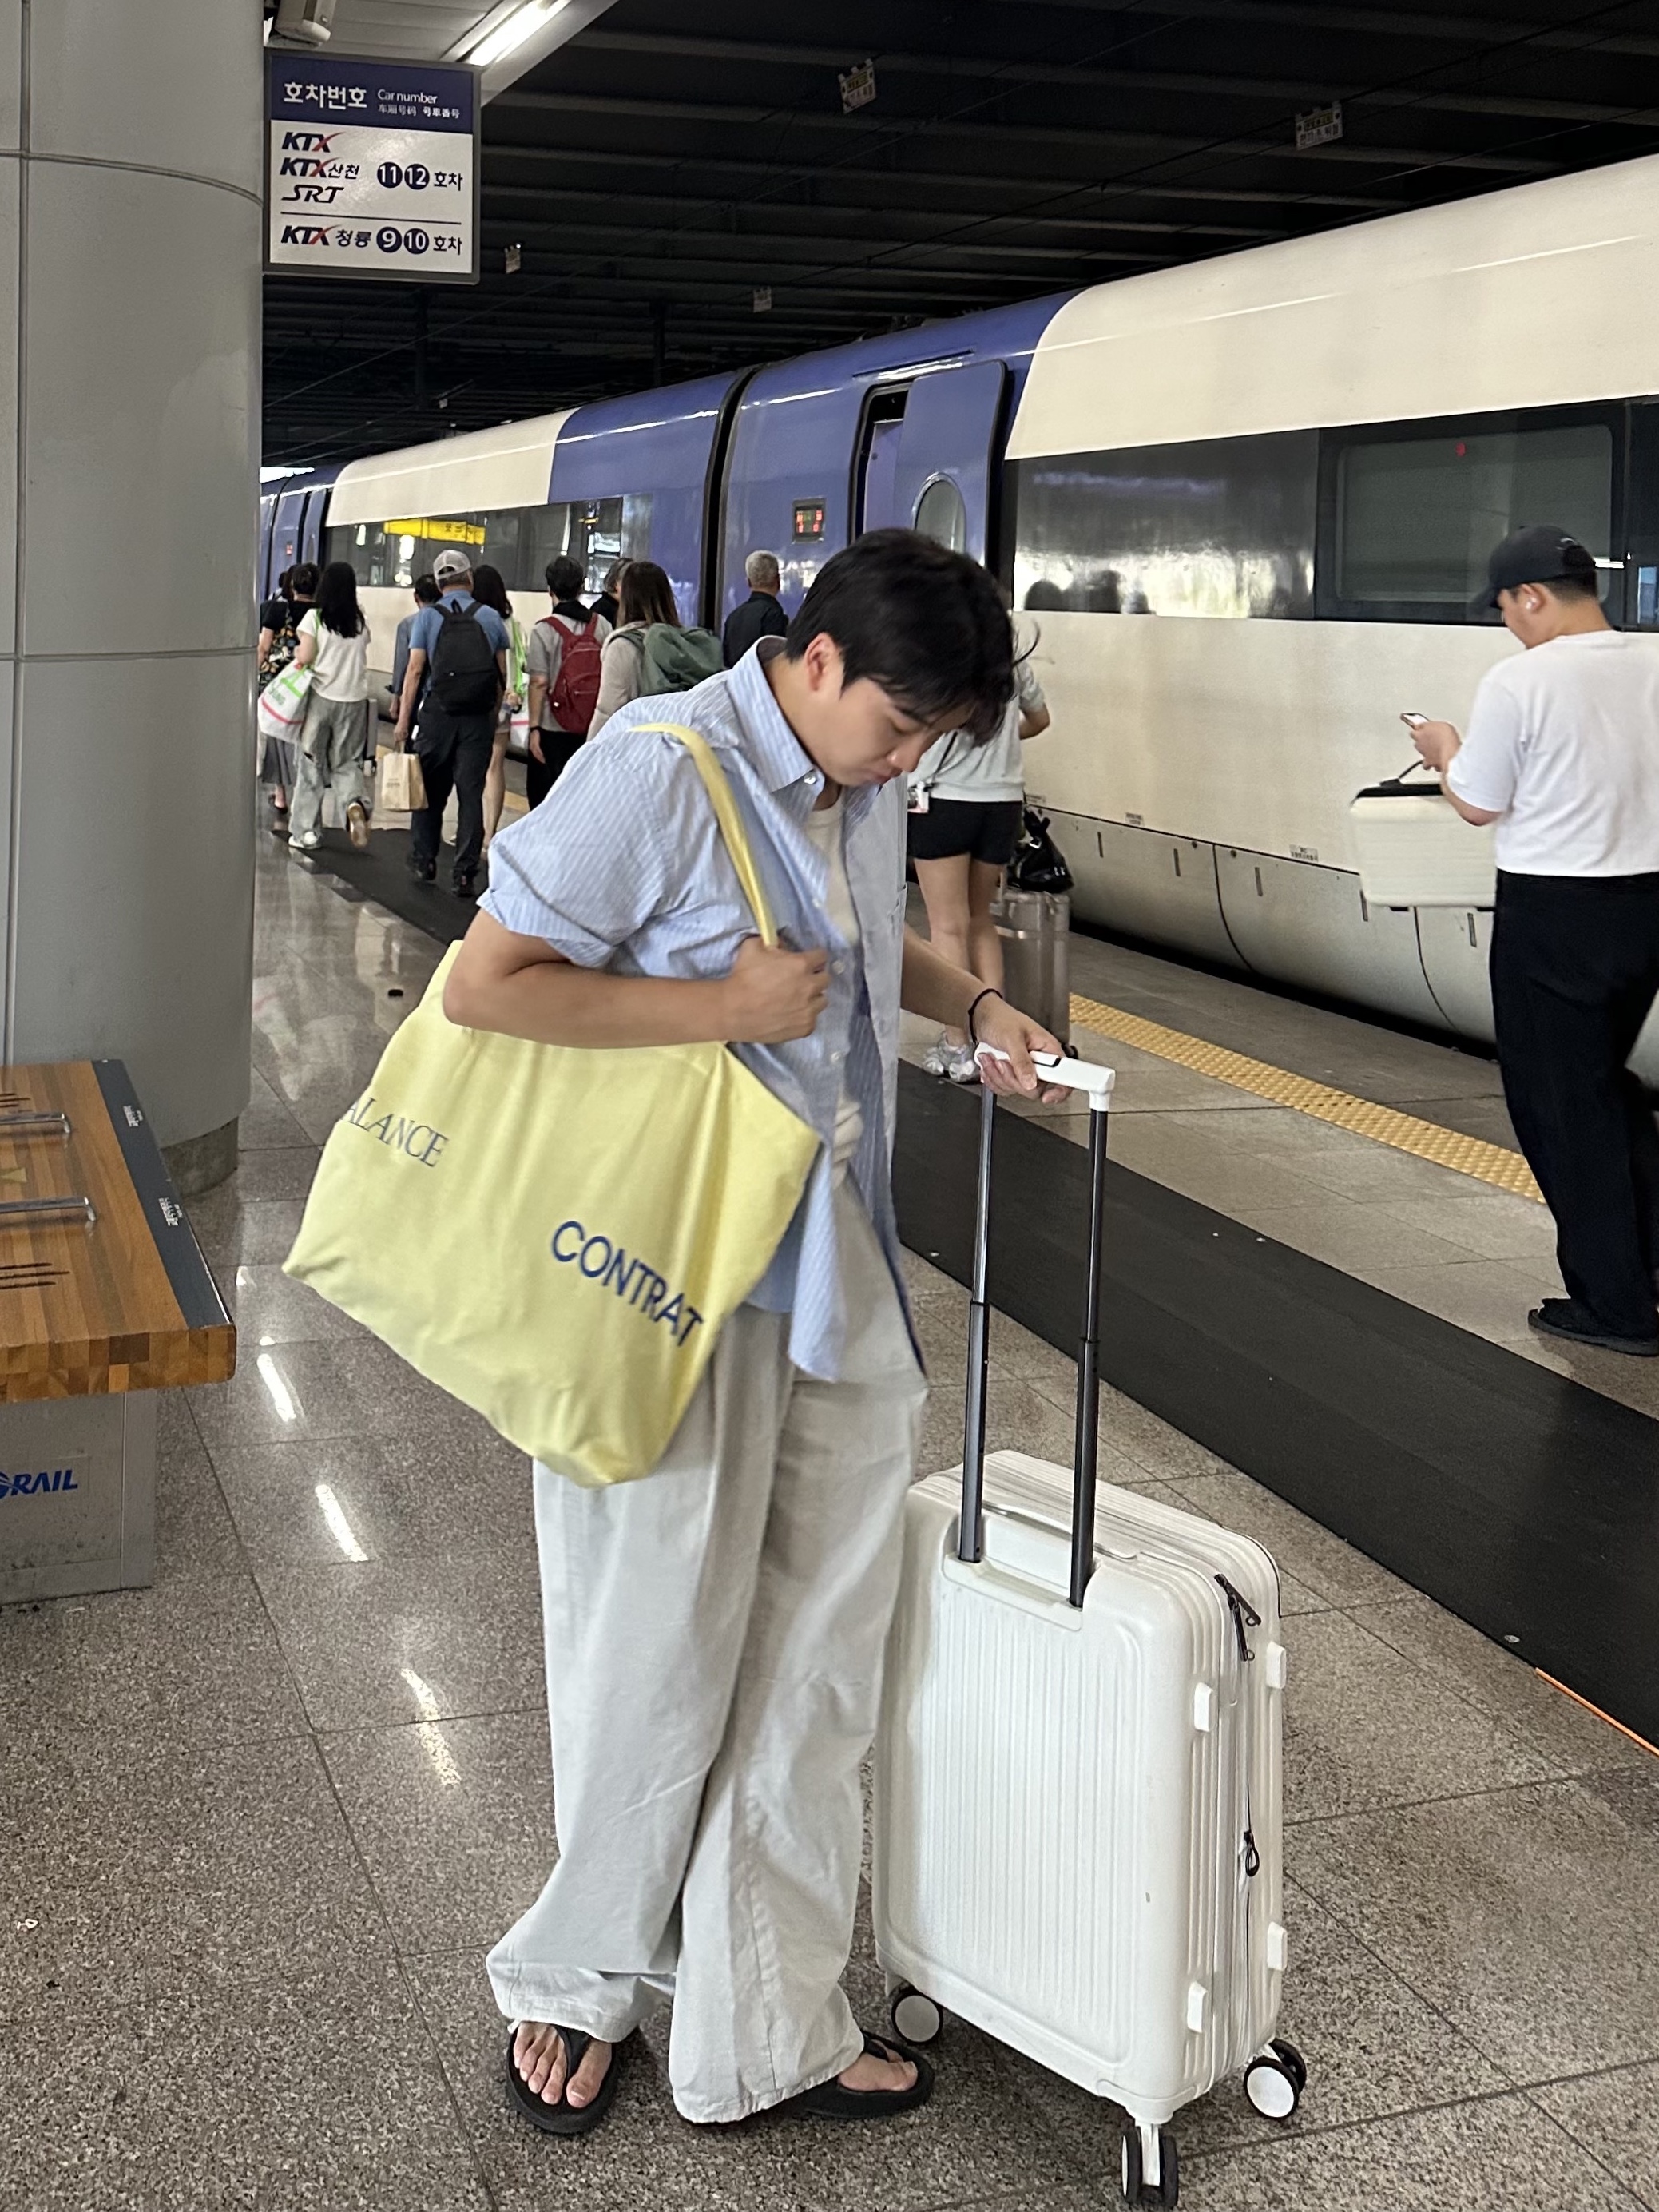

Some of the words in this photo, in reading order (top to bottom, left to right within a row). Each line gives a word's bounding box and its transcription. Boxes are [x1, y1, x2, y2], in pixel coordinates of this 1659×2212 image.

[284, 81, 367, 110] 호차번호
[377, 89, 395, 101] Car
[396, 92, 438, 105] number
[281, 131, 345, 153] KTX
[433, 171, 463, 191] 호차
[281, 184, 344, 204] SRT
[280, 224, 342, 246] KTX
[335, 228, 371, 248] 청룡
[433, 235, 462, 255] 호차
[551, 1221, 704, 1347] CONTRAT
